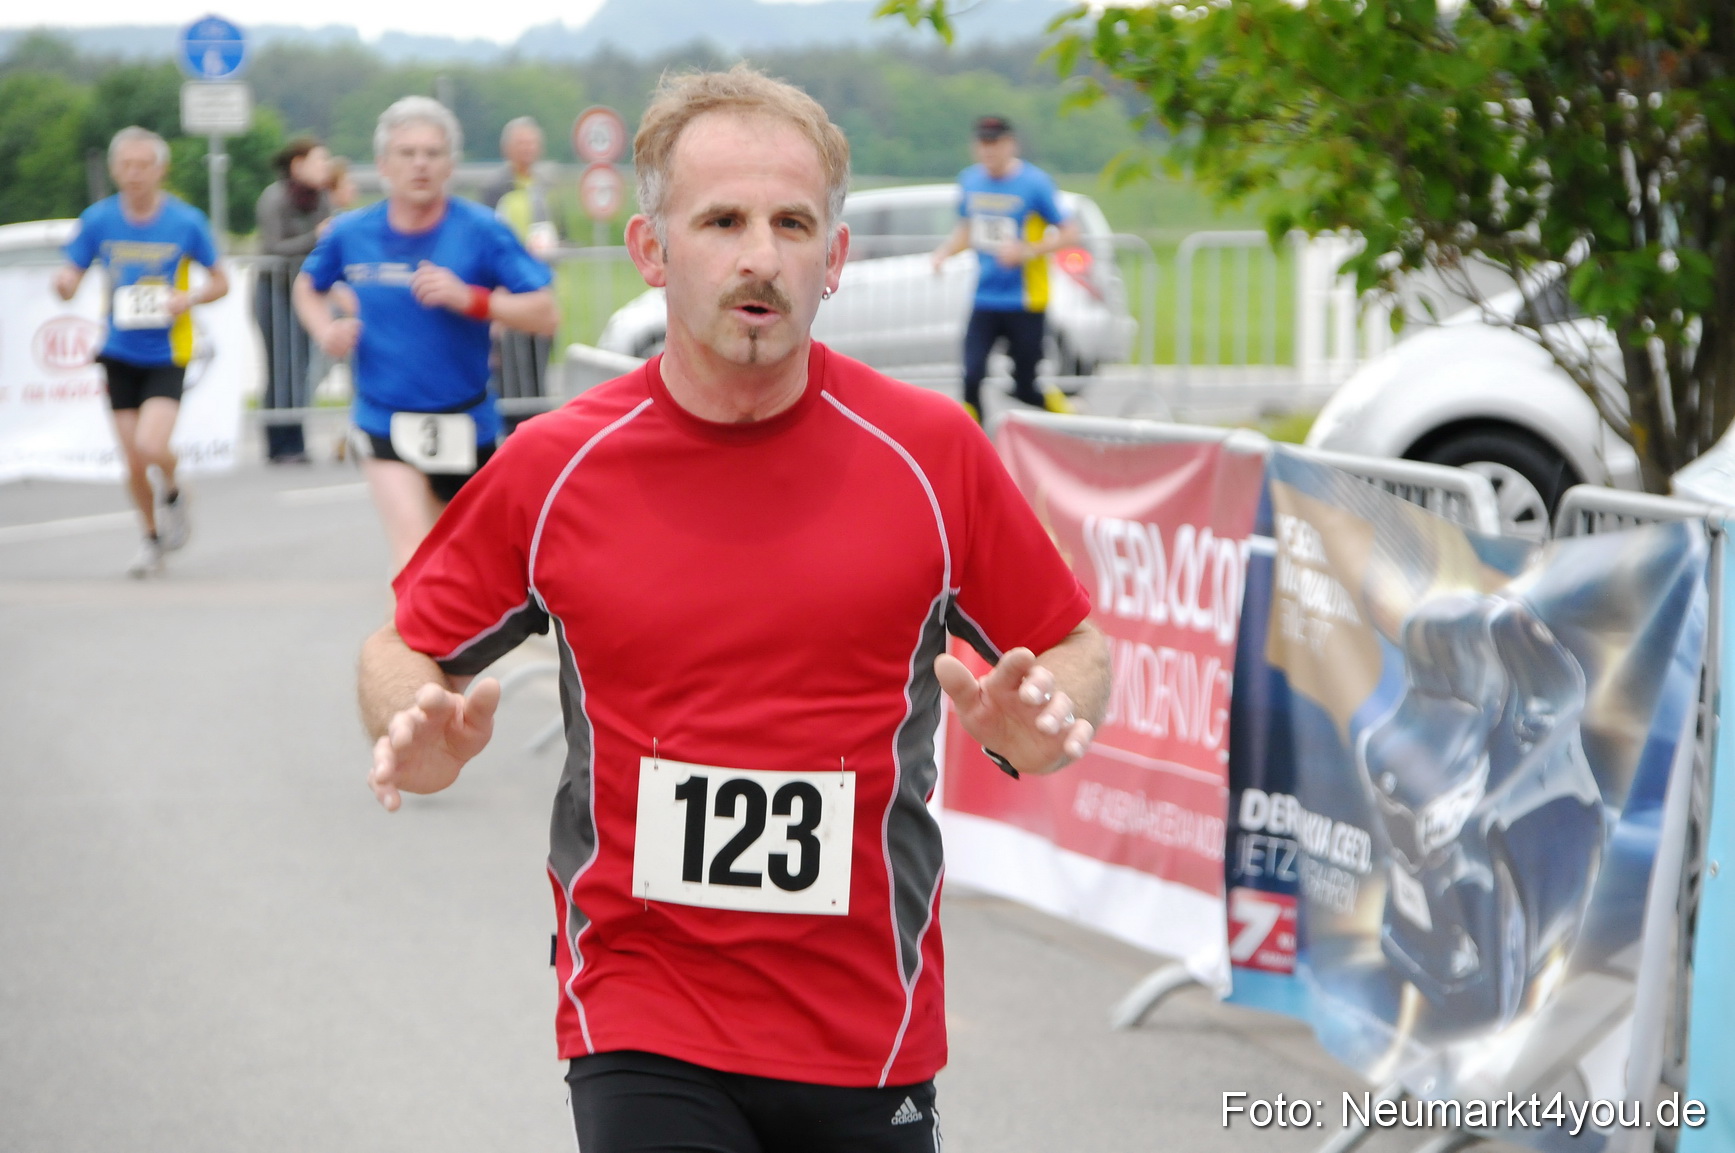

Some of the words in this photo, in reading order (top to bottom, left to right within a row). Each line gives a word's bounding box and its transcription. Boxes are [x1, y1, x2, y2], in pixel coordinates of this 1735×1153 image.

[420, 414, 439, 457] 3
[675, 775, 822, 892] 123
[1230, 890, 1282, 963] 7
[891, 1111, 923, 1126] adidas
